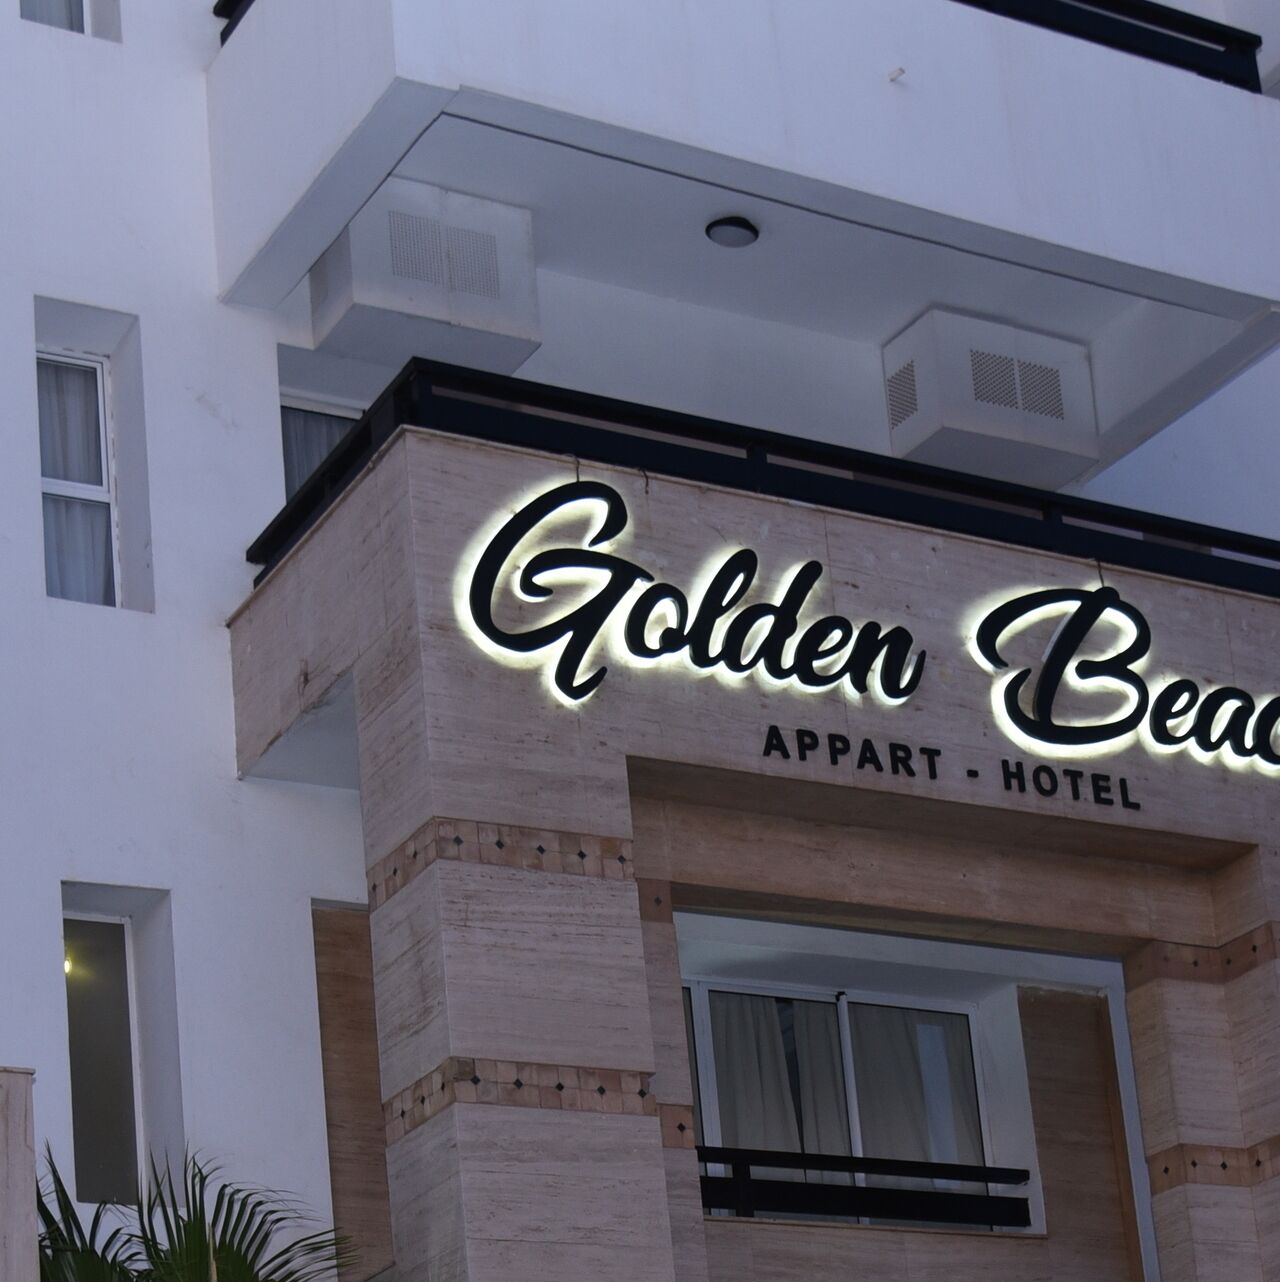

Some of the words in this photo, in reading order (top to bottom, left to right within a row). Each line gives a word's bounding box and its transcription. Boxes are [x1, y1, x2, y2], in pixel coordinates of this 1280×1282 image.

[469, 480, 927, 701] Golden
[762, 724, 942, 780] APPART
[1001, 758, 1142, 811] HOTEL
